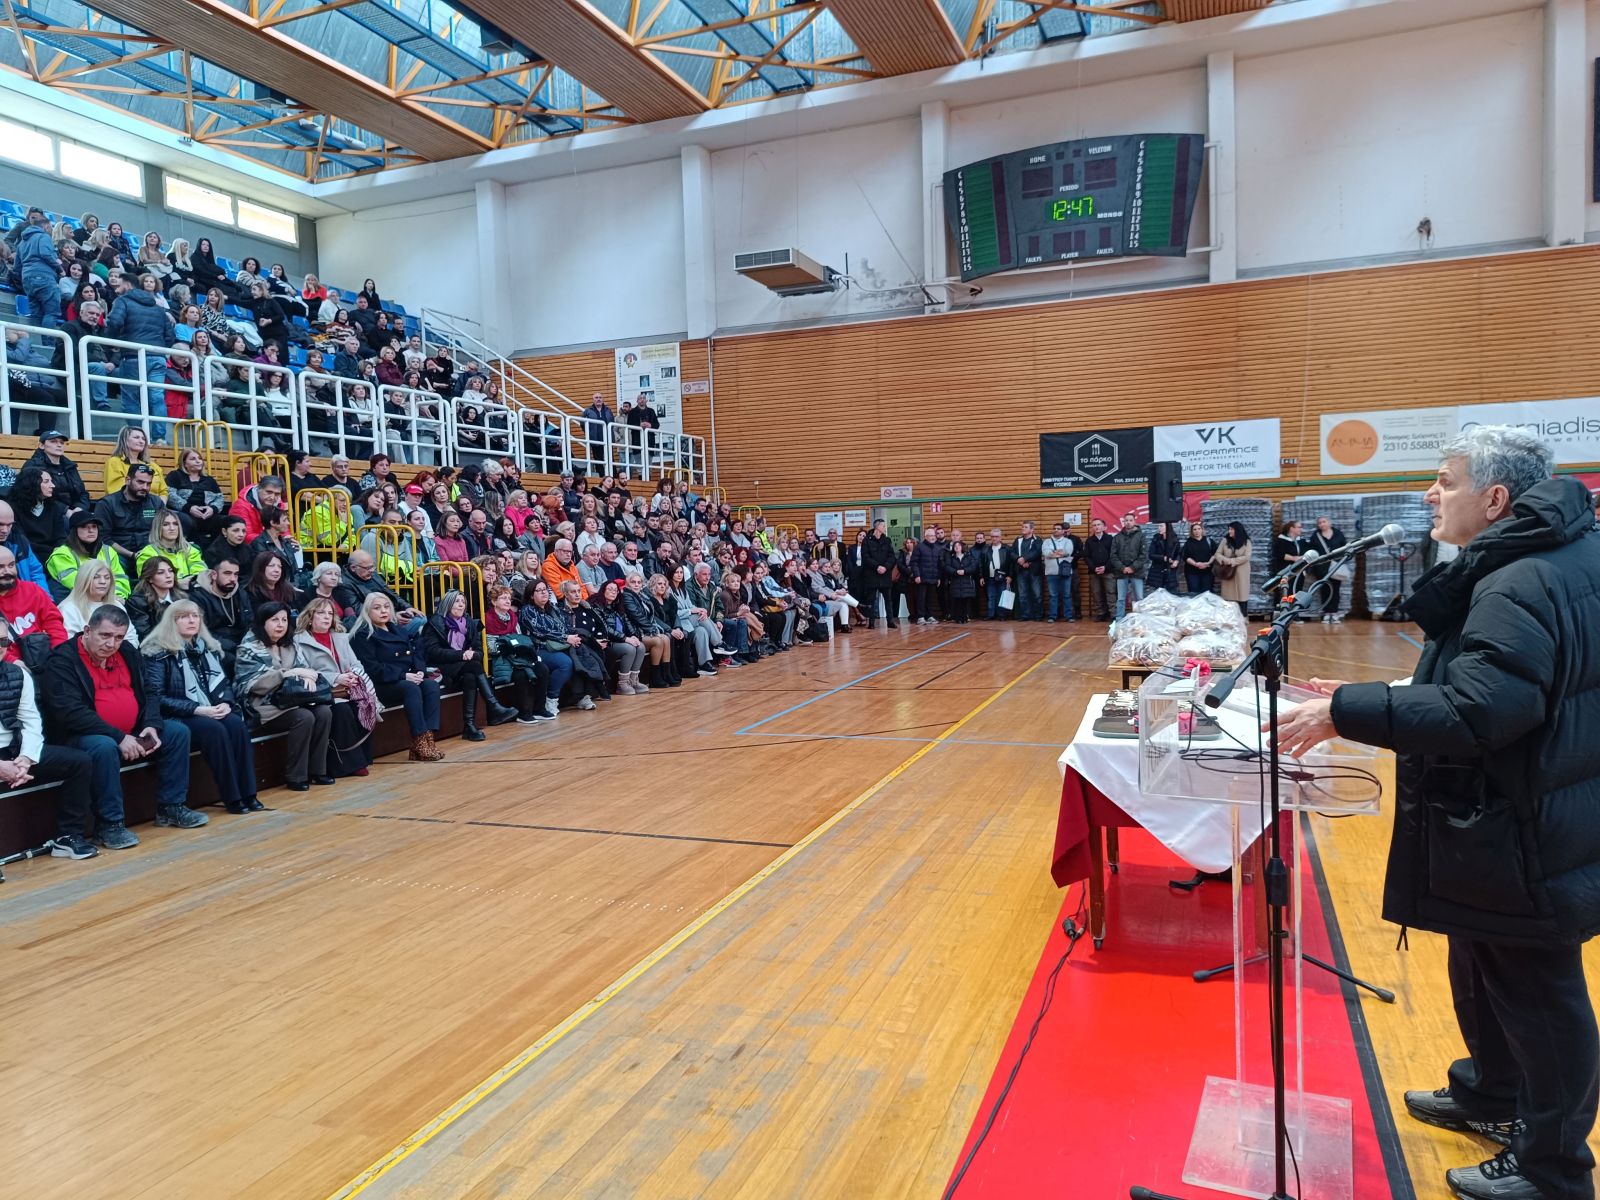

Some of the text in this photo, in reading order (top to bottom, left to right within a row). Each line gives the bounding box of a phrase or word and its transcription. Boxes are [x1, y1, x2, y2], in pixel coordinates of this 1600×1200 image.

[1029, 155, 1047, 164] HOME
[1059, 184, 1080, 192] PERIOD
[1053, 196, 1094, 221] 12:47
[1096, 247, 1114, 255] FAULTS
[1194, 425, 1236, 446] VK
[1173, 445, 1260, 458] PERFORMANCE
[1383, 442, 1407, 452] 2310
[1181, 461, 1257, 472] UILT FOR THE GAME
